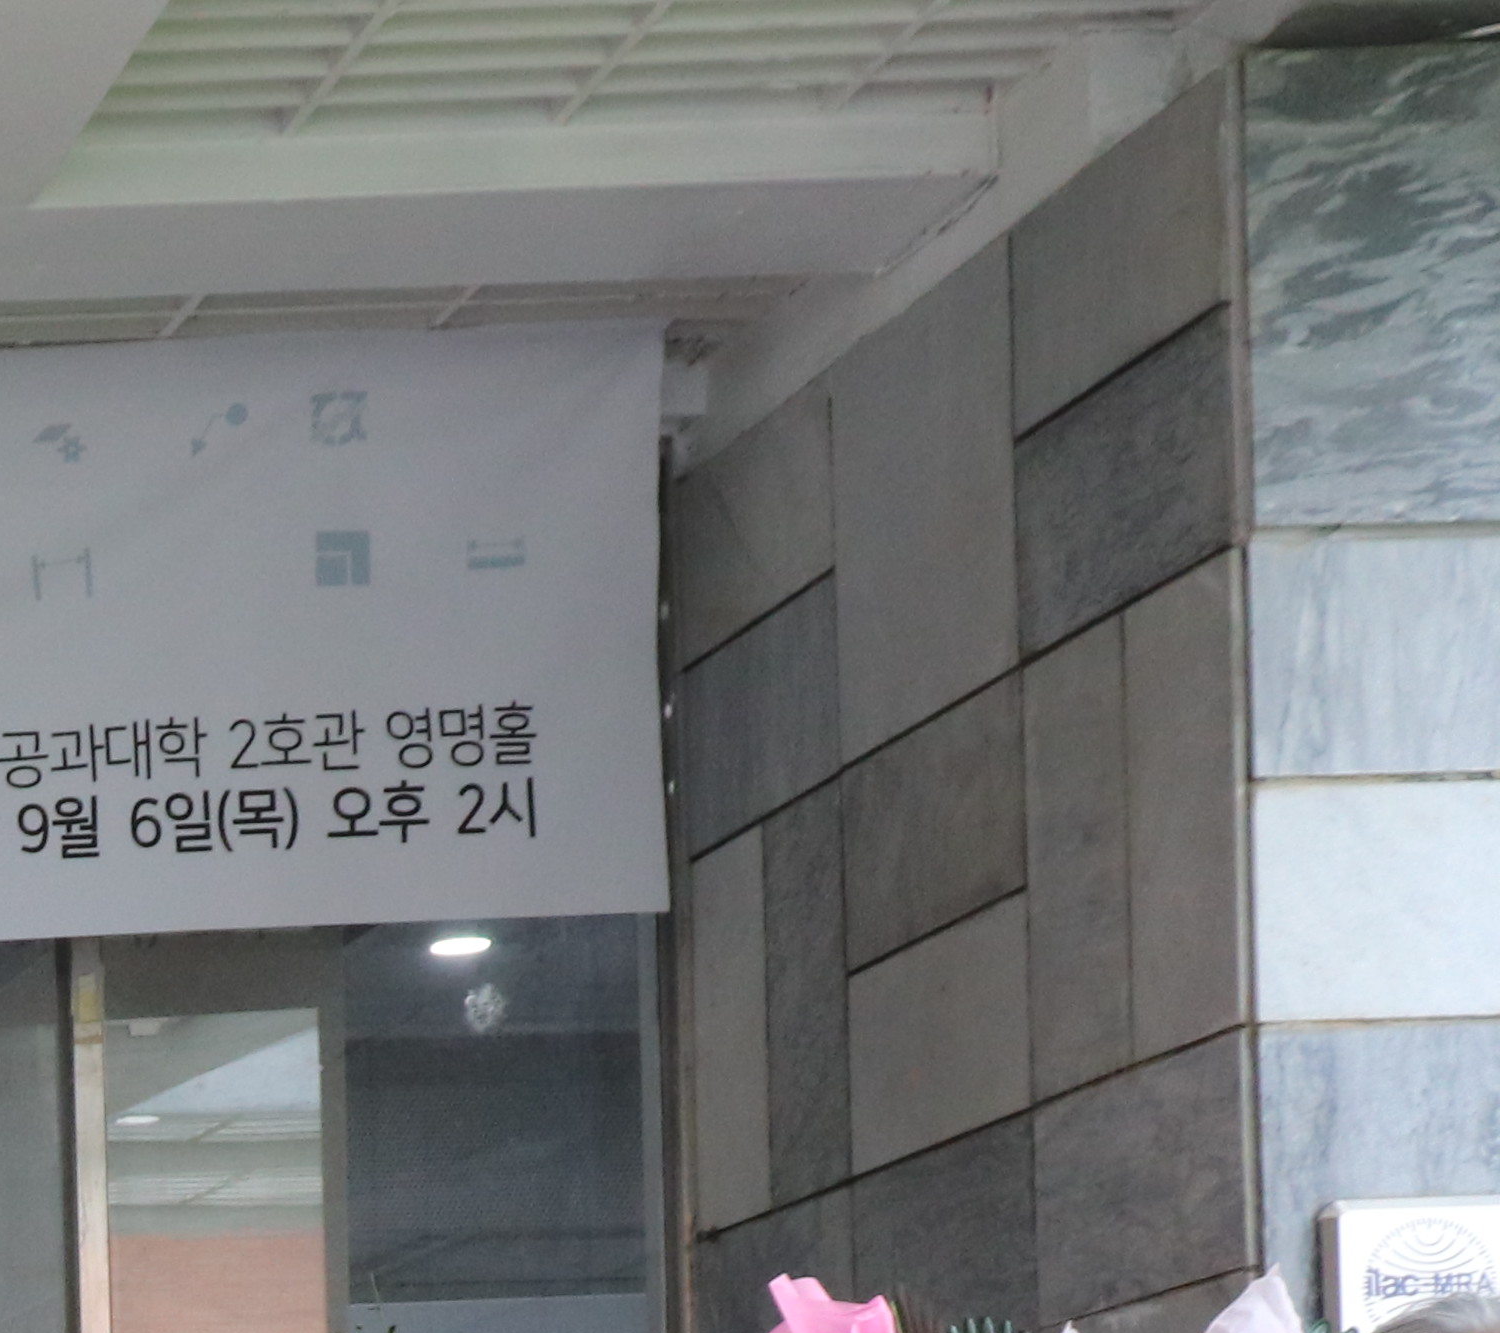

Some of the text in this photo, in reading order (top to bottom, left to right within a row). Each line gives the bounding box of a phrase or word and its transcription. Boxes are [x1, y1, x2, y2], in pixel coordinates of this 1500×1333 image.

[228, 710, 366, 772] 2호관
[385, 701, 537, 769] 영명홀
[16, 802, 101, 860] 9월
[129, 787, 300, 854] 6일(목)
[326, 779, 430, 844] 오후
[456, 777, 537, 838] 2시
